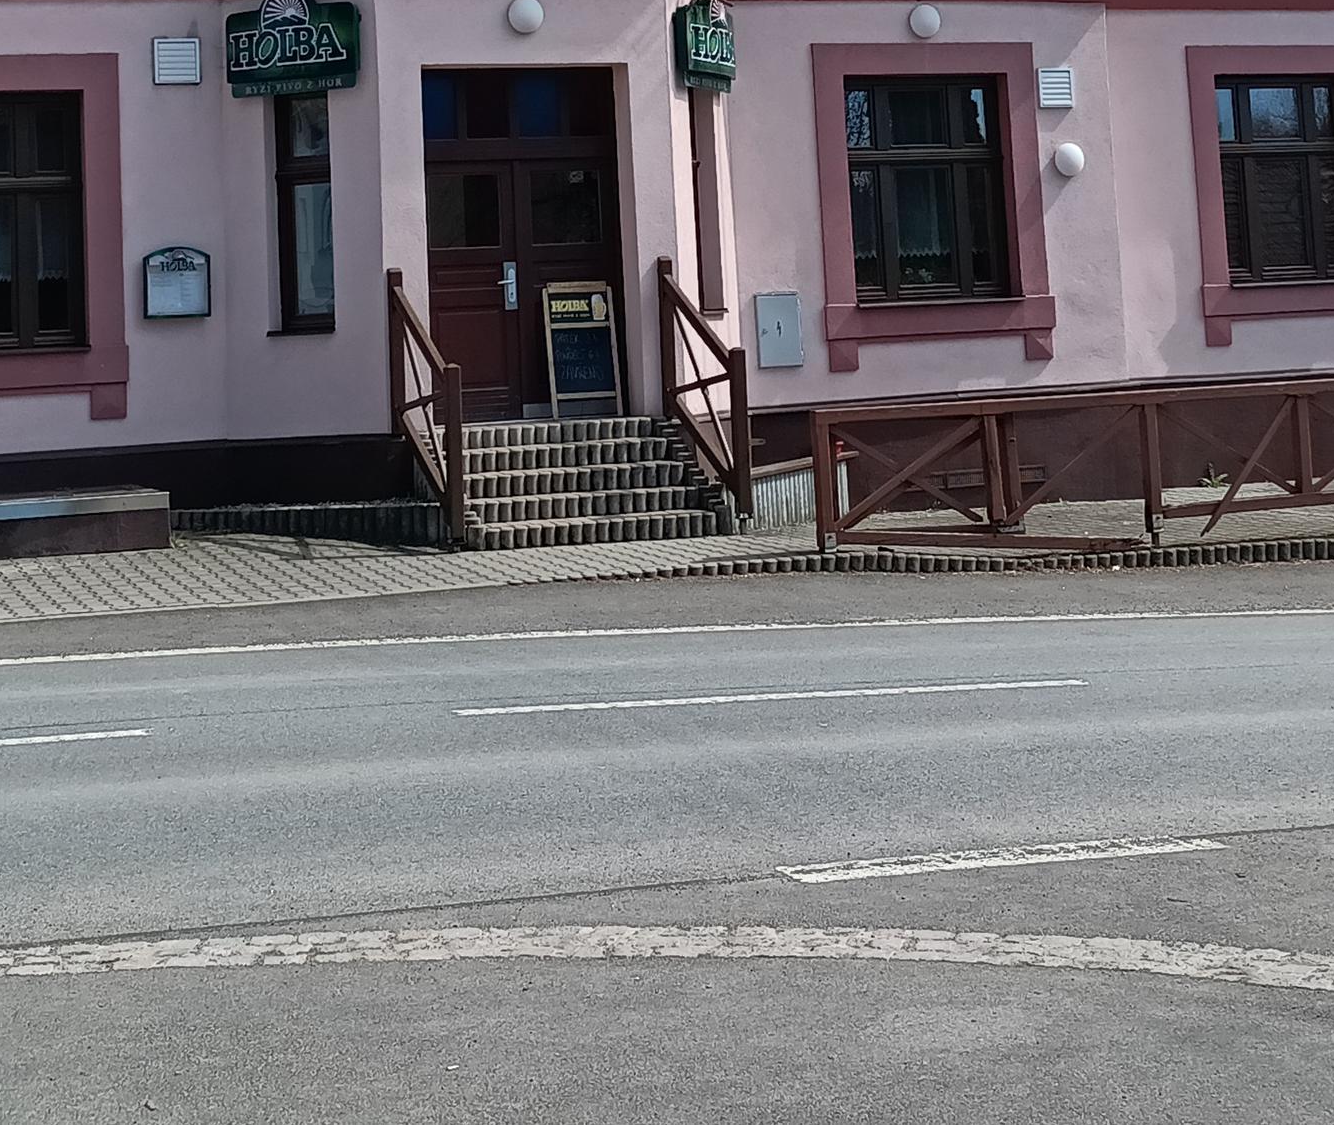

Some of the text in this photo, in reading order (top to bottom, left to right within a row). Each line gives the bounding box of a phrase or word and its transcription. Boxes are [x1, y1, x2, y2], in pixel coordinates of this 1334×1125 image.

[230, 23, 347, 71] HOLBA
[318, 77, 343, 88] HOR
[159, 261, 197, 272] HOLBA
[550, 299, 590, 313] HOLBA
